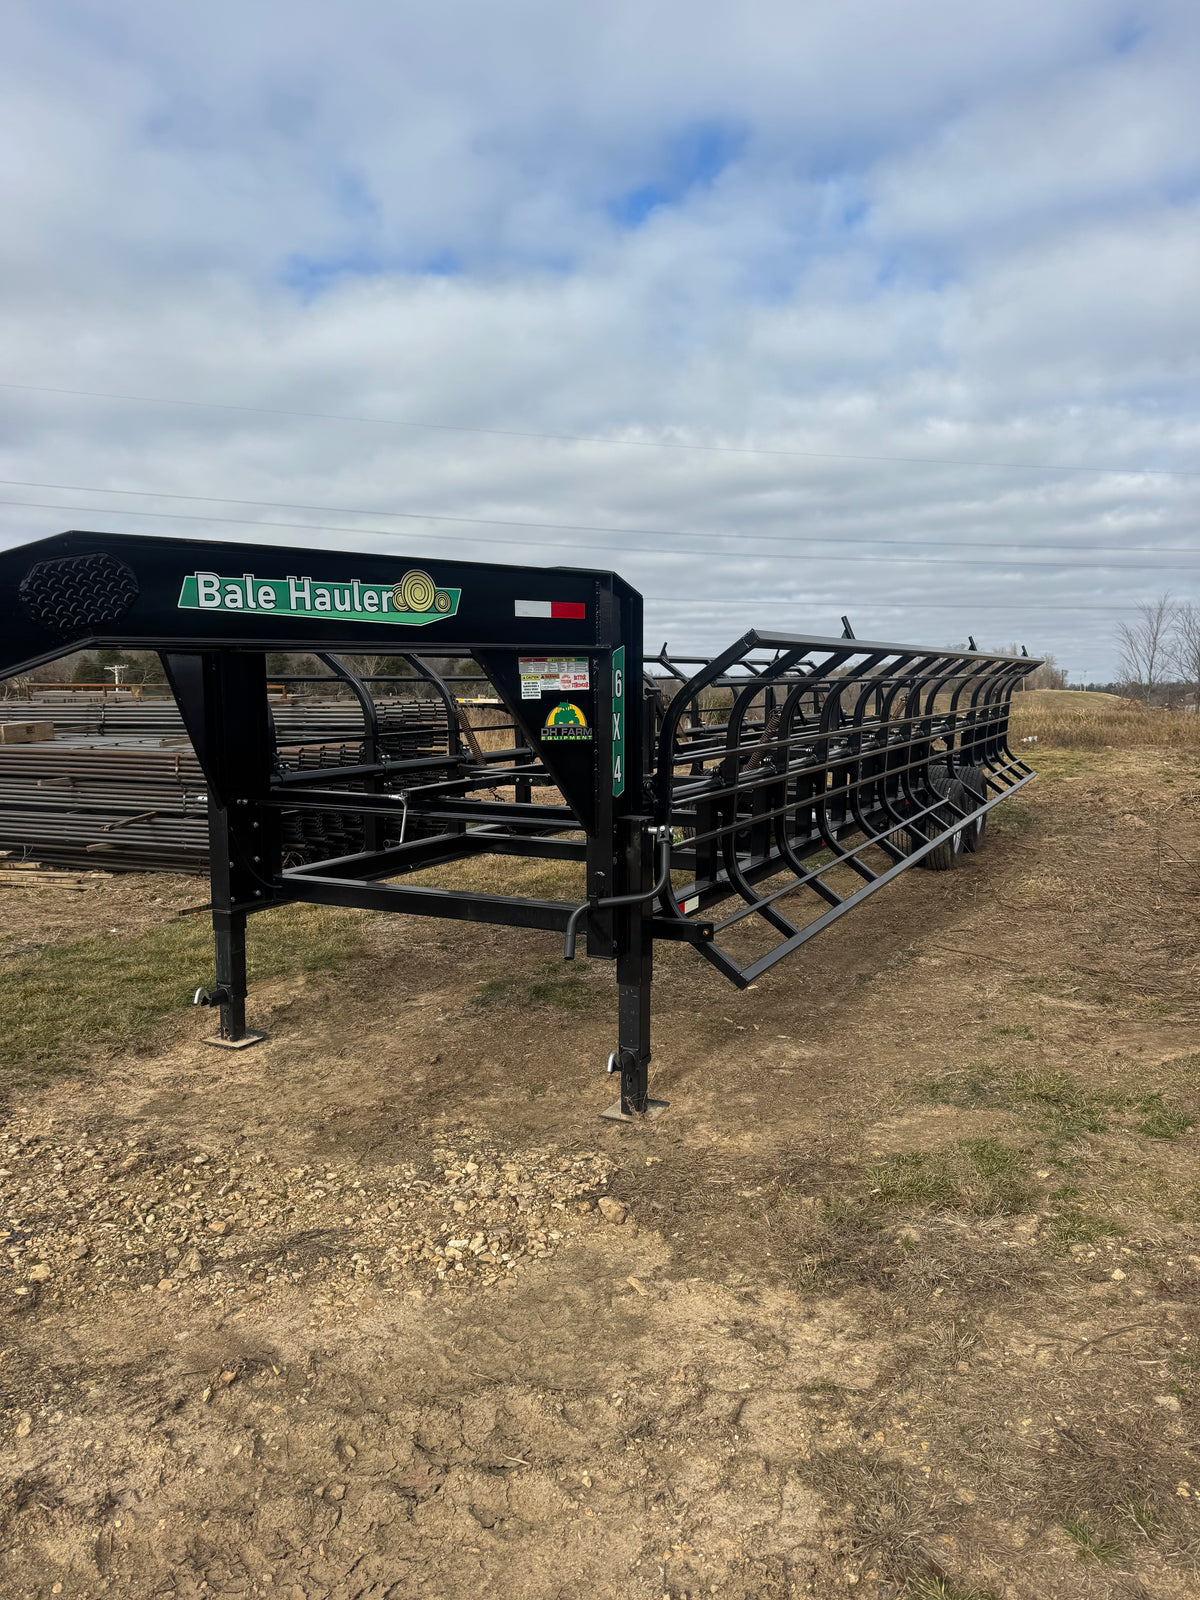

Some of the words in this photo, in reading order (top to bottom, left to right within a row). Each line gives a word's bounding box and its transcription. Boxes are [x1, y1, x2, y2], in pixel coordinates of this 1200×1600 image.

[196, 573, 277, 610] Bale
[288, 577, 394, 613] Hauler
[541, 728, 558, 736] DH
[561, 728, 593, 736] FARM
